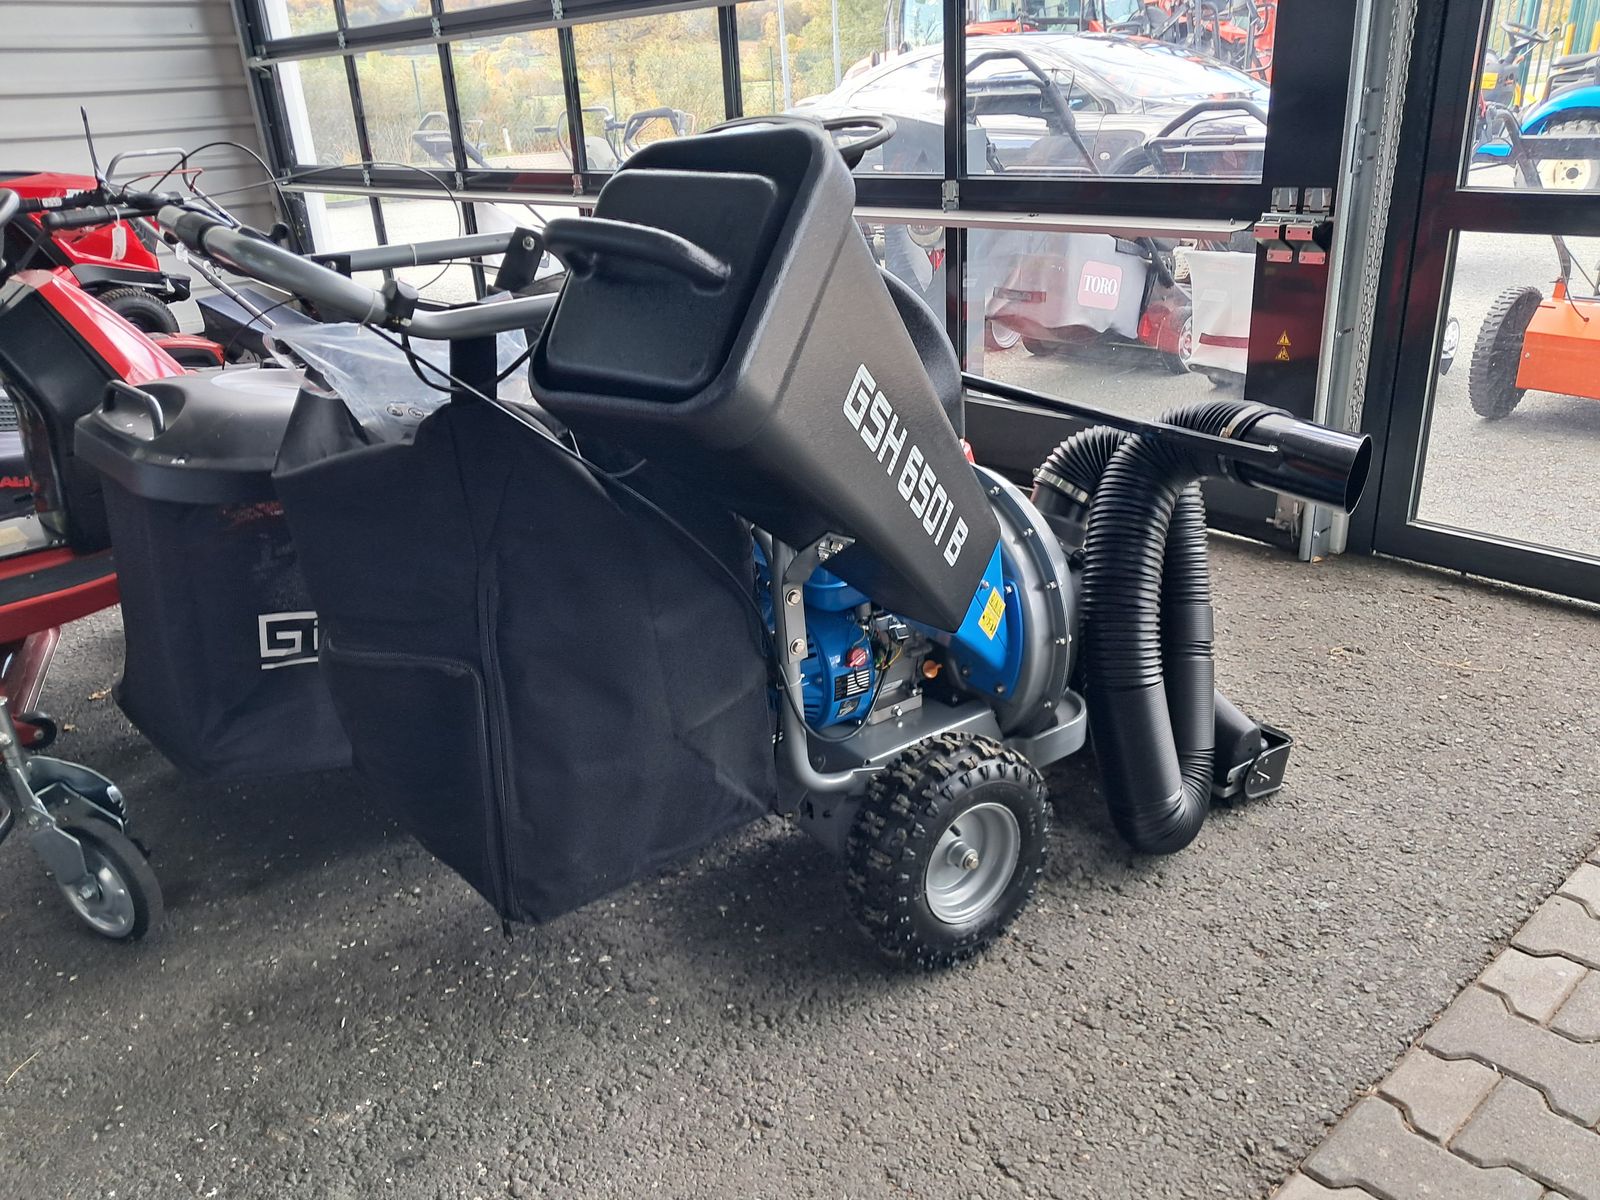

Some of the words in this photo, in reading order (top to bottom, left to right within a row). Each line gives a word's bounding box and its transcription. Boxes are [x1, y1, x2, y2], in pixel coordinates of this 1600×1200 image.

[1083, 274, 1118, 296] TORO
[843, 363, 908, 477] GSH
[897, 444, 955, 546] 6501
[943, 516, 969, 567] B
